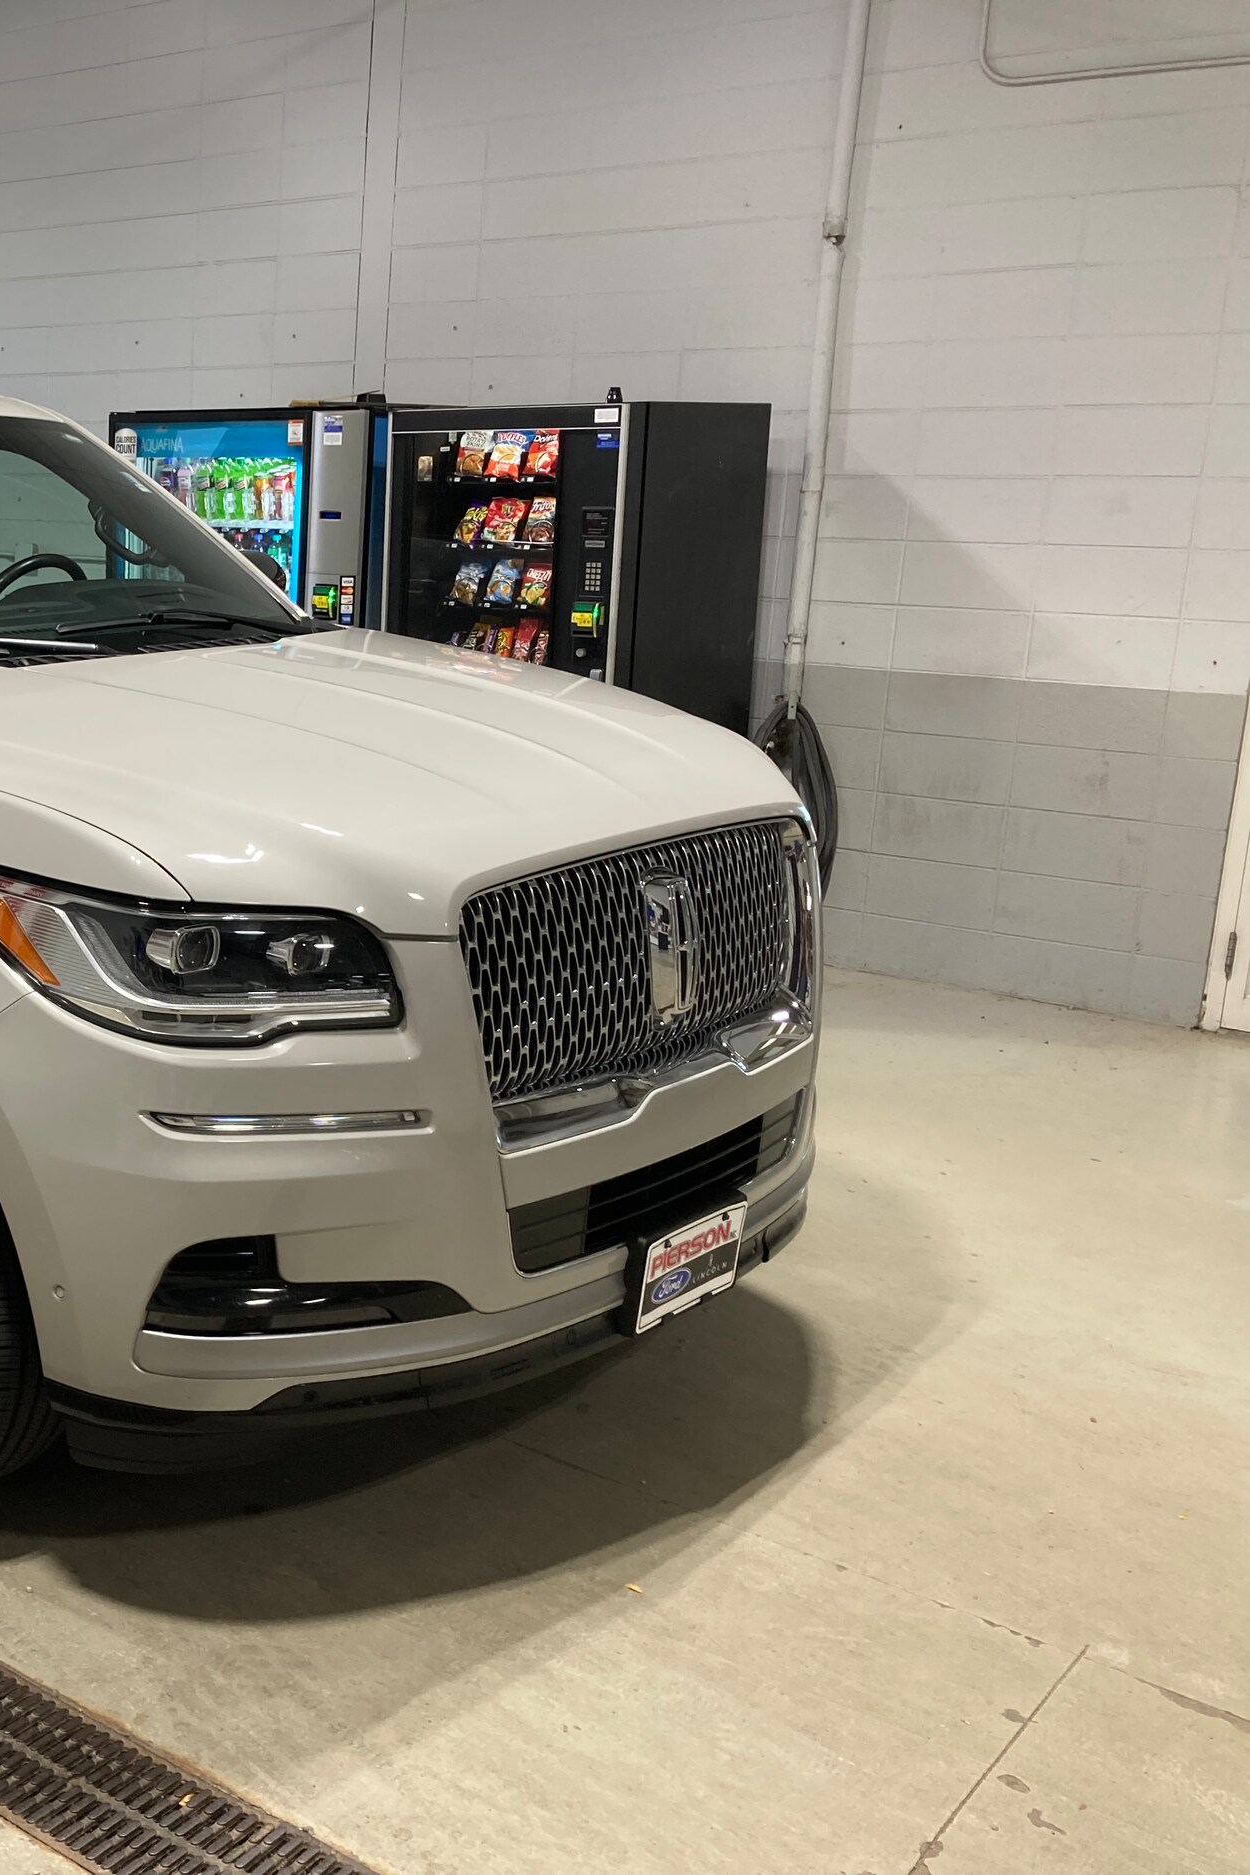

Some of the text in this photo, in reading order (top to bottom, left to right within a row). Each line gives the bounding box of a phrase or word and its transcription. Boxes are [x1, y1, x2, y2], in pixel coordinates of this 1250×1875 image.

[115, 436, 136, 444] CALORIES
[141, 437, 184, 454] AQUAFINA
[497, 431, 527, 445] RUFFLES
[115, 443, 136, 454] COUNT
[650, 1220, 732, 1278] PIERSON
[691, 1261, 728, 1285] LINCOLN
